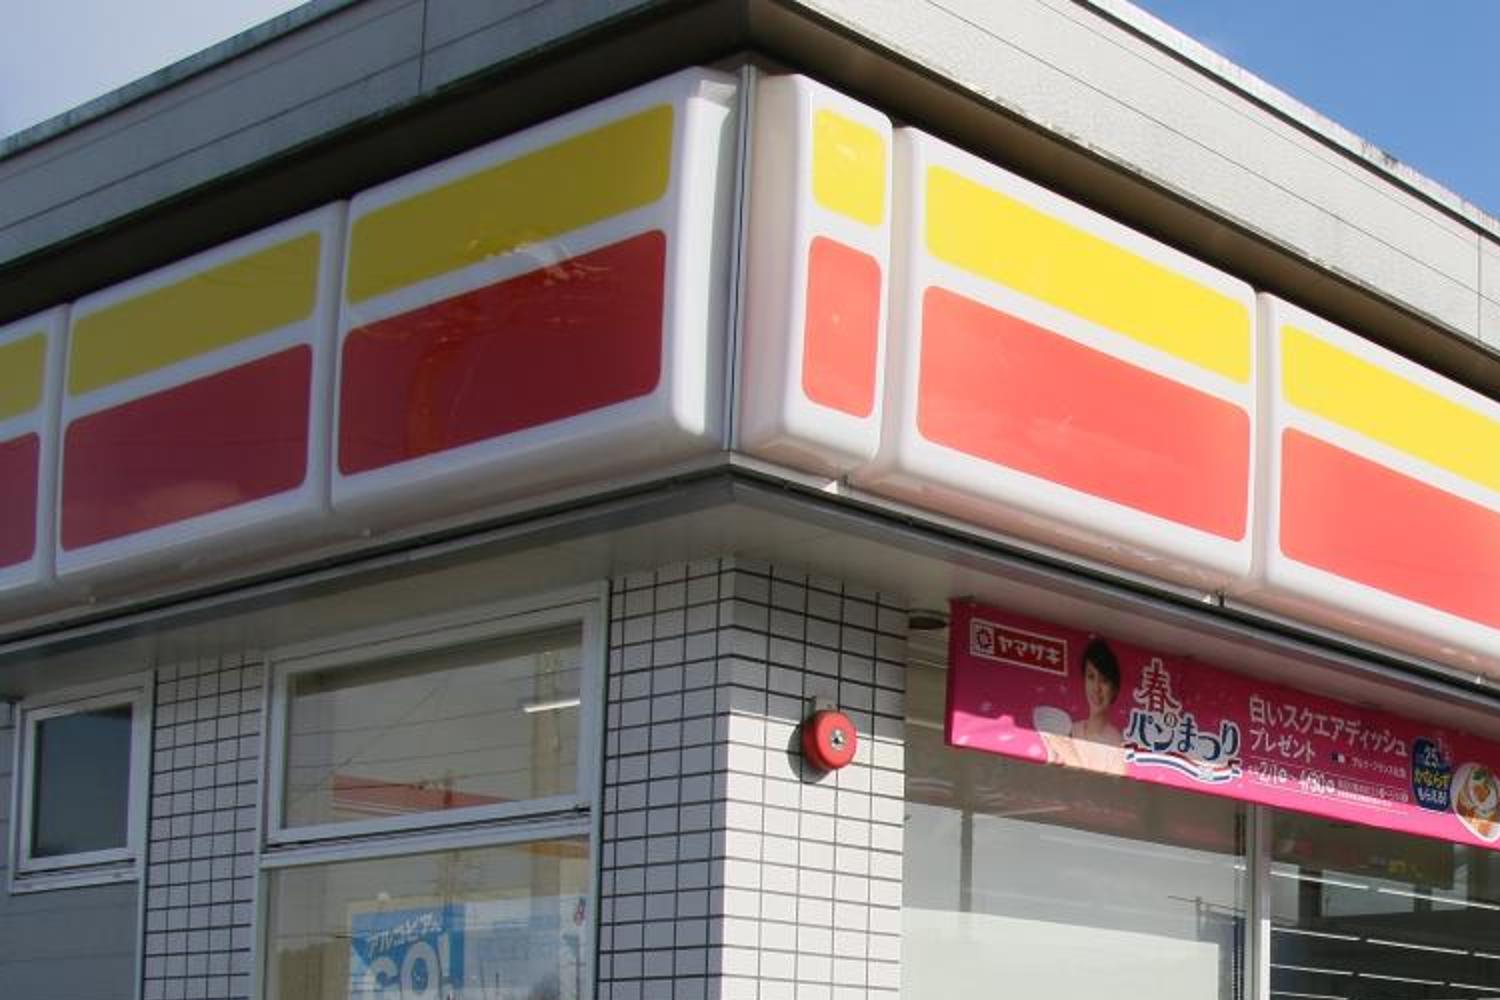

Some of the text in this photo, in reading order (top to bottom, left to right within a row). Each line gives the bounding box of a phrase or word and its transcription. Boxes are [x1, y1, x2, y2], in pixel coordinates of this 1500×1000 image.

[997, 634, 1062, 665] ヤマザキ
[1124, 710, 1240, 762] パンまつり
[1249, 695, 1408, 757] 白いスクエアディッシュ
[1249, 727, 1315, 763] プレゼント
